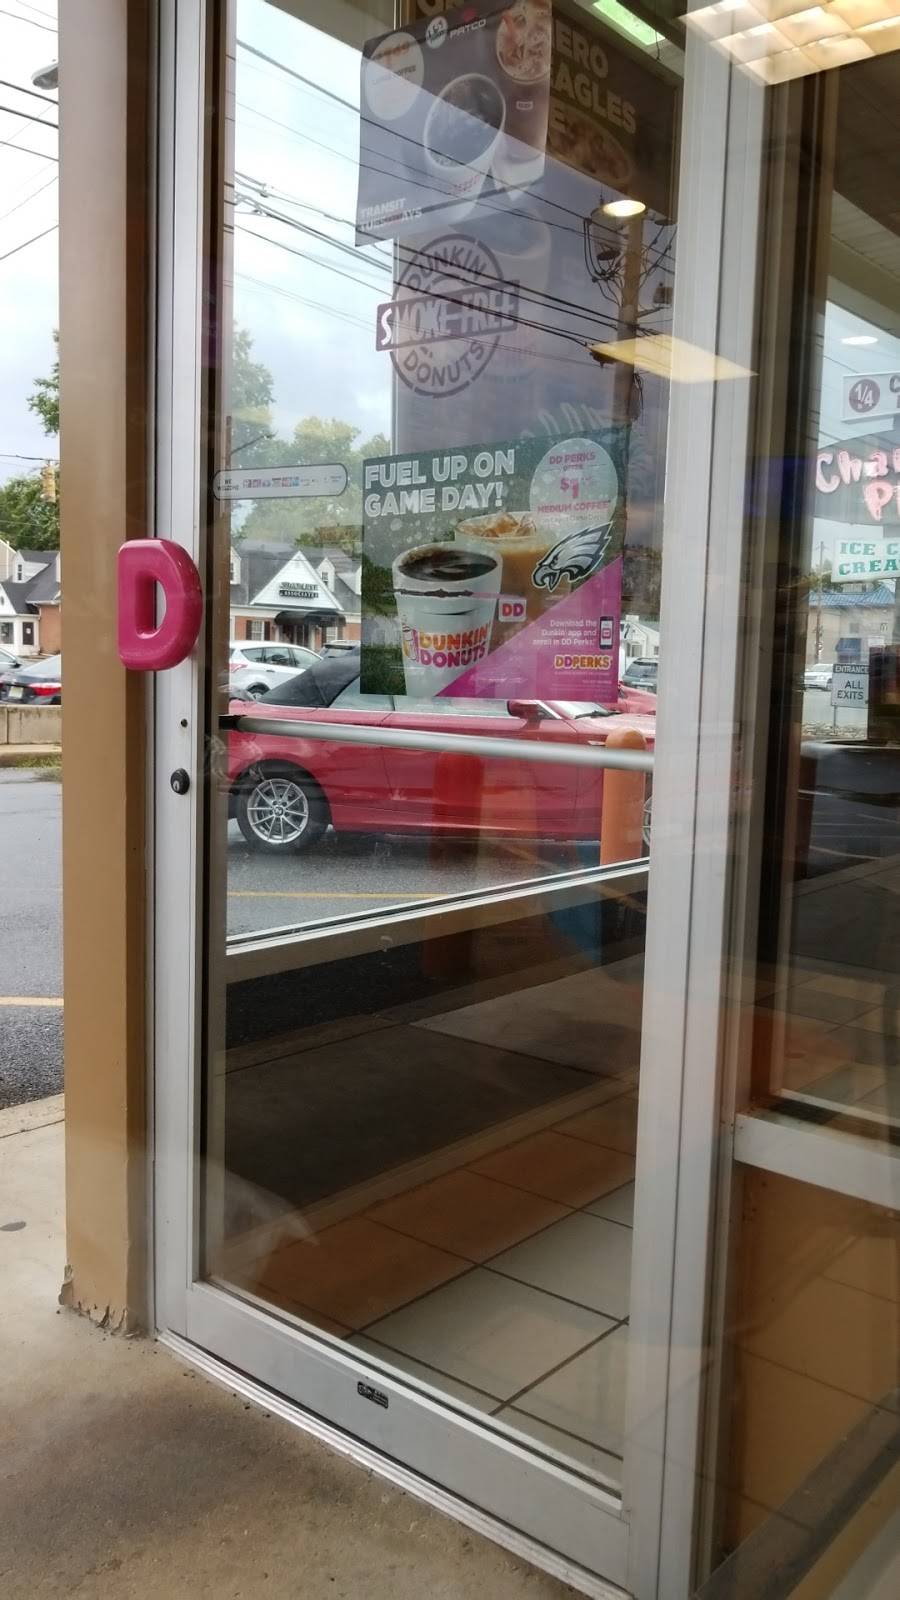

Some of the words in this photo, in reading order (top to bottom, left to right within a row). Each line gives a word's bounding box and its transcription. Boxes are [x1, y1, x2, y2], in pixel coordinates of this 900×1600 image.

[552, 19, 608, 78] ERO
[551, 62, 637, 134] AGLES
[361, 198, 405, 220] TRANSIT
[381, 290, 514, 346] SMOKE-FREE
[404, 342, 485, 387] DONUTS
[549, 455, 563, 464] DD
[564, 451, 596, 463] PERKS
[365, 460, 427, 489] FUEL
[432, 455, 468, 482] UP
[473, 449, 515, 478] ON
[364, 488, 435, 517] GAME
[442, 481, 503, 511] DAY!
[537, 503, 572, 514] MEDIUM
[840, 542, 876, 555] ICE
[838, 559, 900, 575] CREA
[501, 602, 525, 618] DD
[561, 638, 573, 646] DD
[568, 630, 582, 638] app
[419, 643, 486, 668] DONUTS
[844, 680, 864, 689] ALL
[836, 690, 864, 700] EXITS
